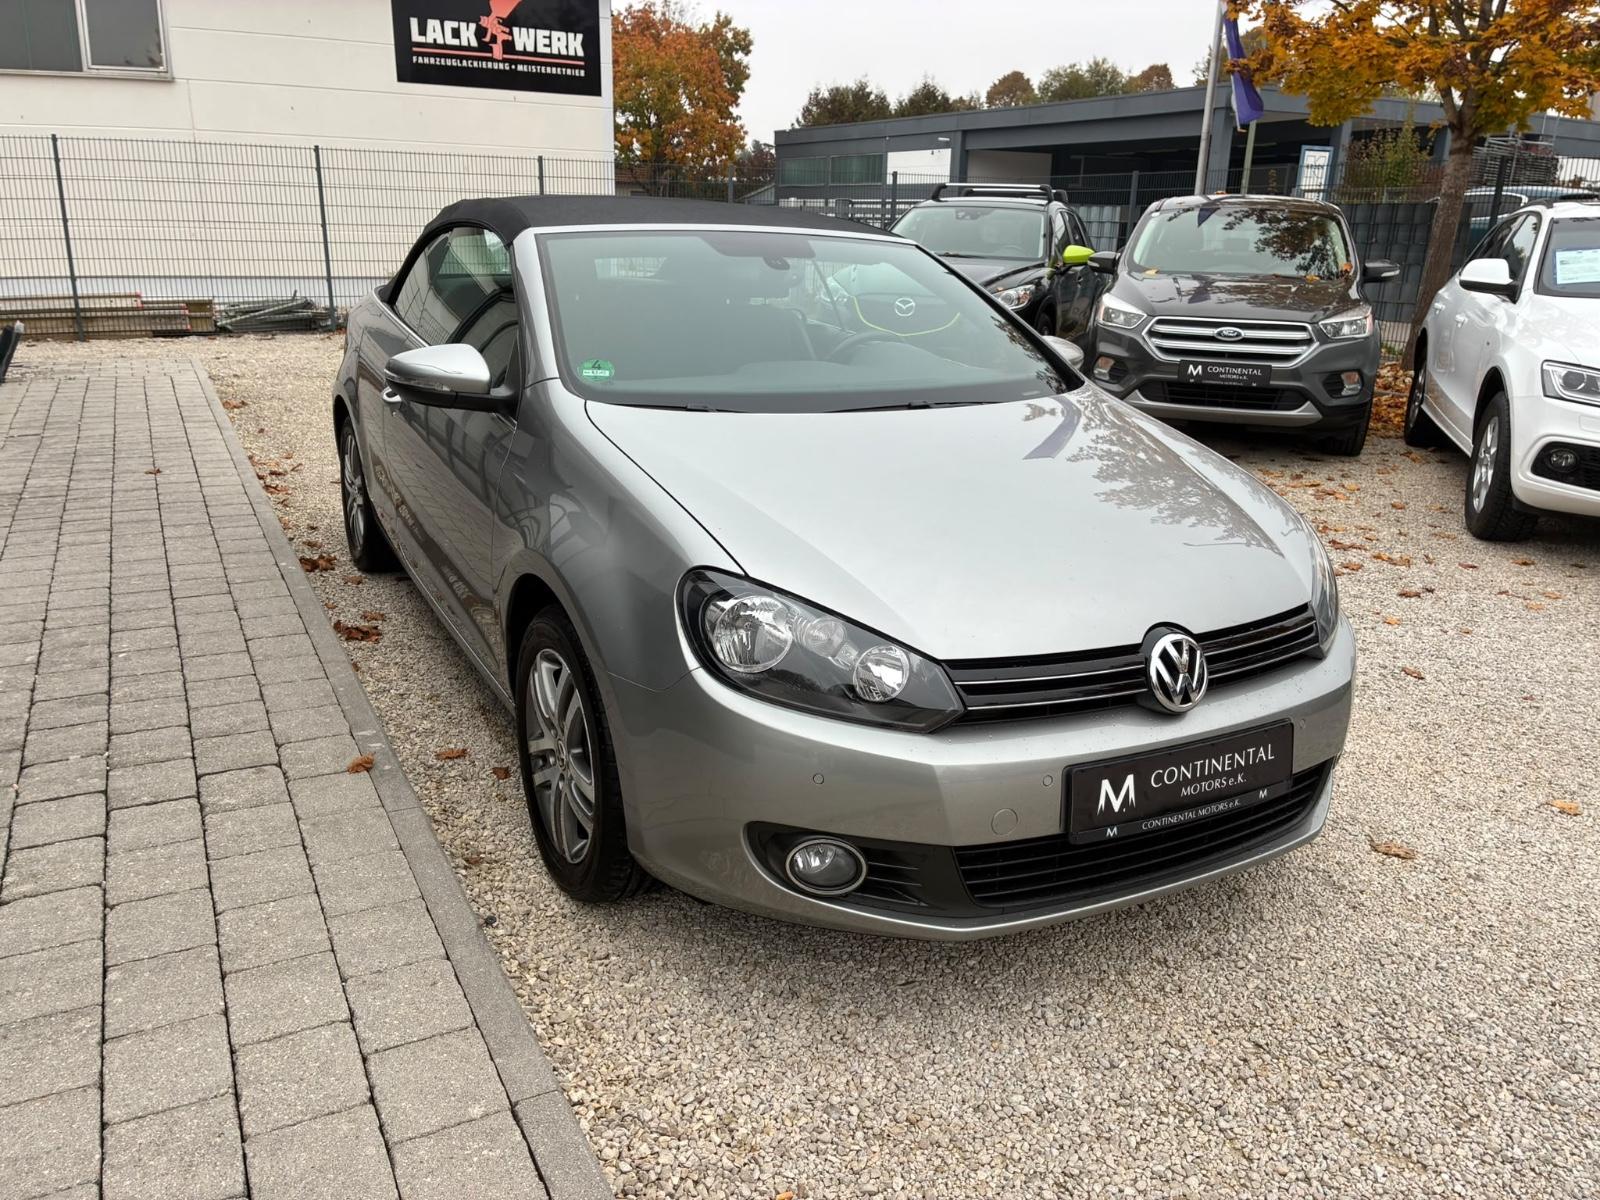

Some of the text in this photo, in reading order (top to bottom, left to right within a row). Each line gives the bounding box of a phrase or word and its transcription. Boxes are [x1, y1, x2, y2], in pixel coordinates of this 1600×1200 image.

[409, 17, 584, 57] LACK WERK
[412, 55, 585, 77] FAHRZEUGLACKIERUNG MEISTERBETRIEB
[592, 359, 601, 370] 4
[1187, 364, 1262, 377] M CONTINENTAL
[1150, 743, 1275, 788] CONTINENTAL
[1181, 772, 1247, 798] MOTORS e.K.
[1258, 788, 1268, 799] M
[1142, 810, 1196, 830] CONTINENTAL
[1198, 802, 1228, 817] MOTORS
[1106, 826, 1118, 838] M
